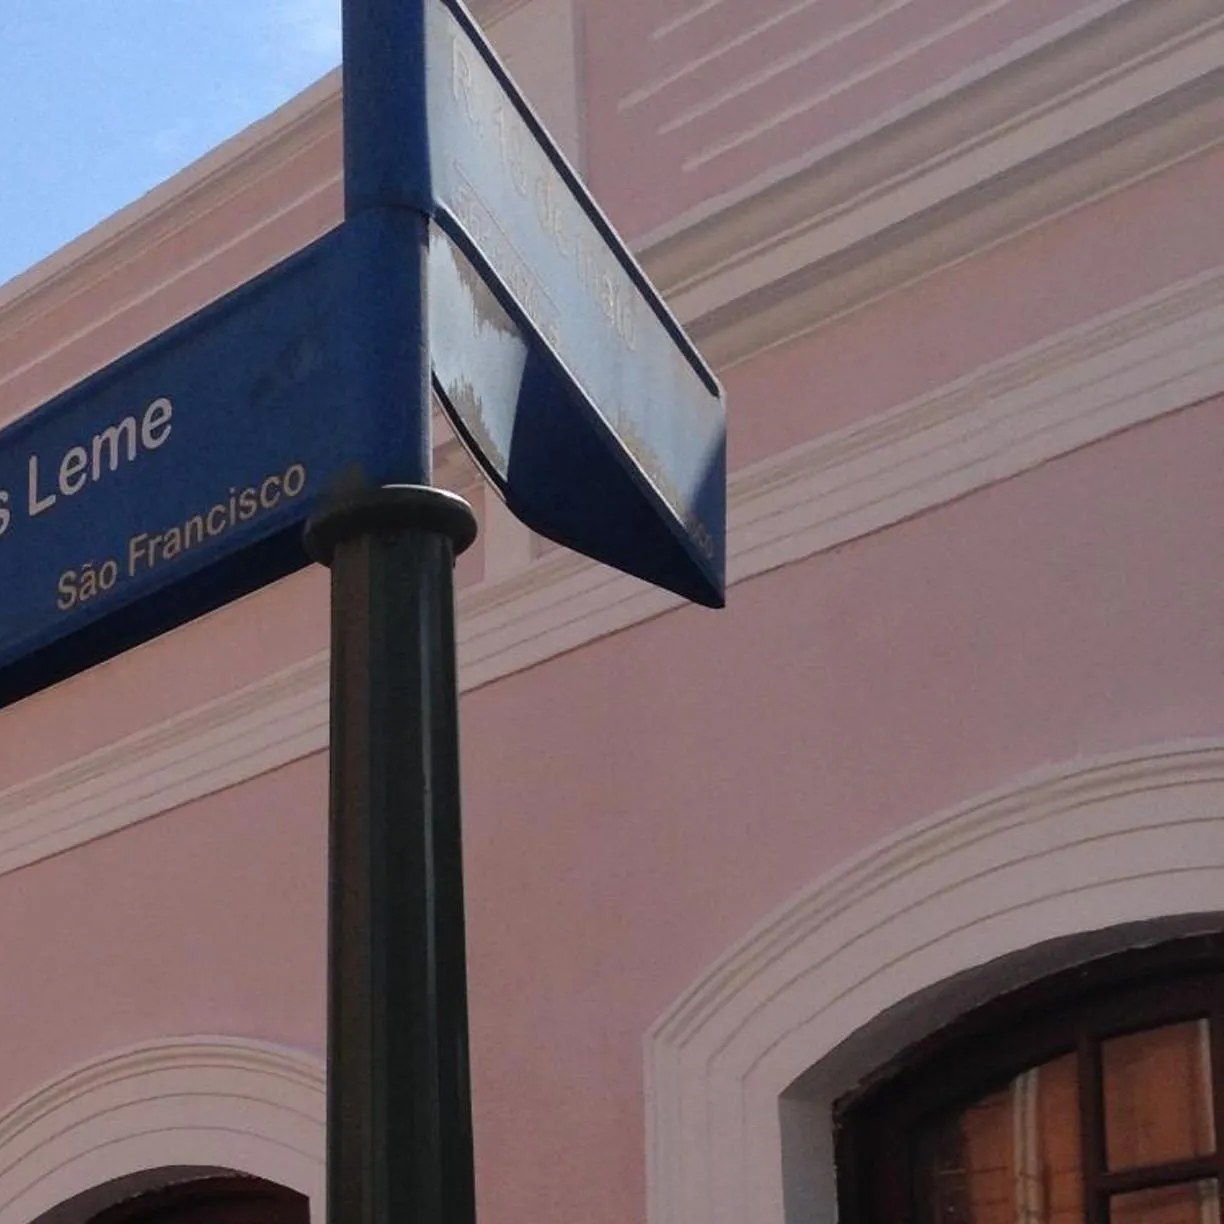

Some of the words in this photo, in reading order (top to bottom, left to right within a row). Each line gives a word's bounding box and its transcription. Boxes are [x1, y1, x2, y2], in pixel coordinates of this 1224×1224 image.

[28, 397, 173, 516] Leme
[57, 559, 117, 609] São
[128, 464, 305, 575] Francisco
